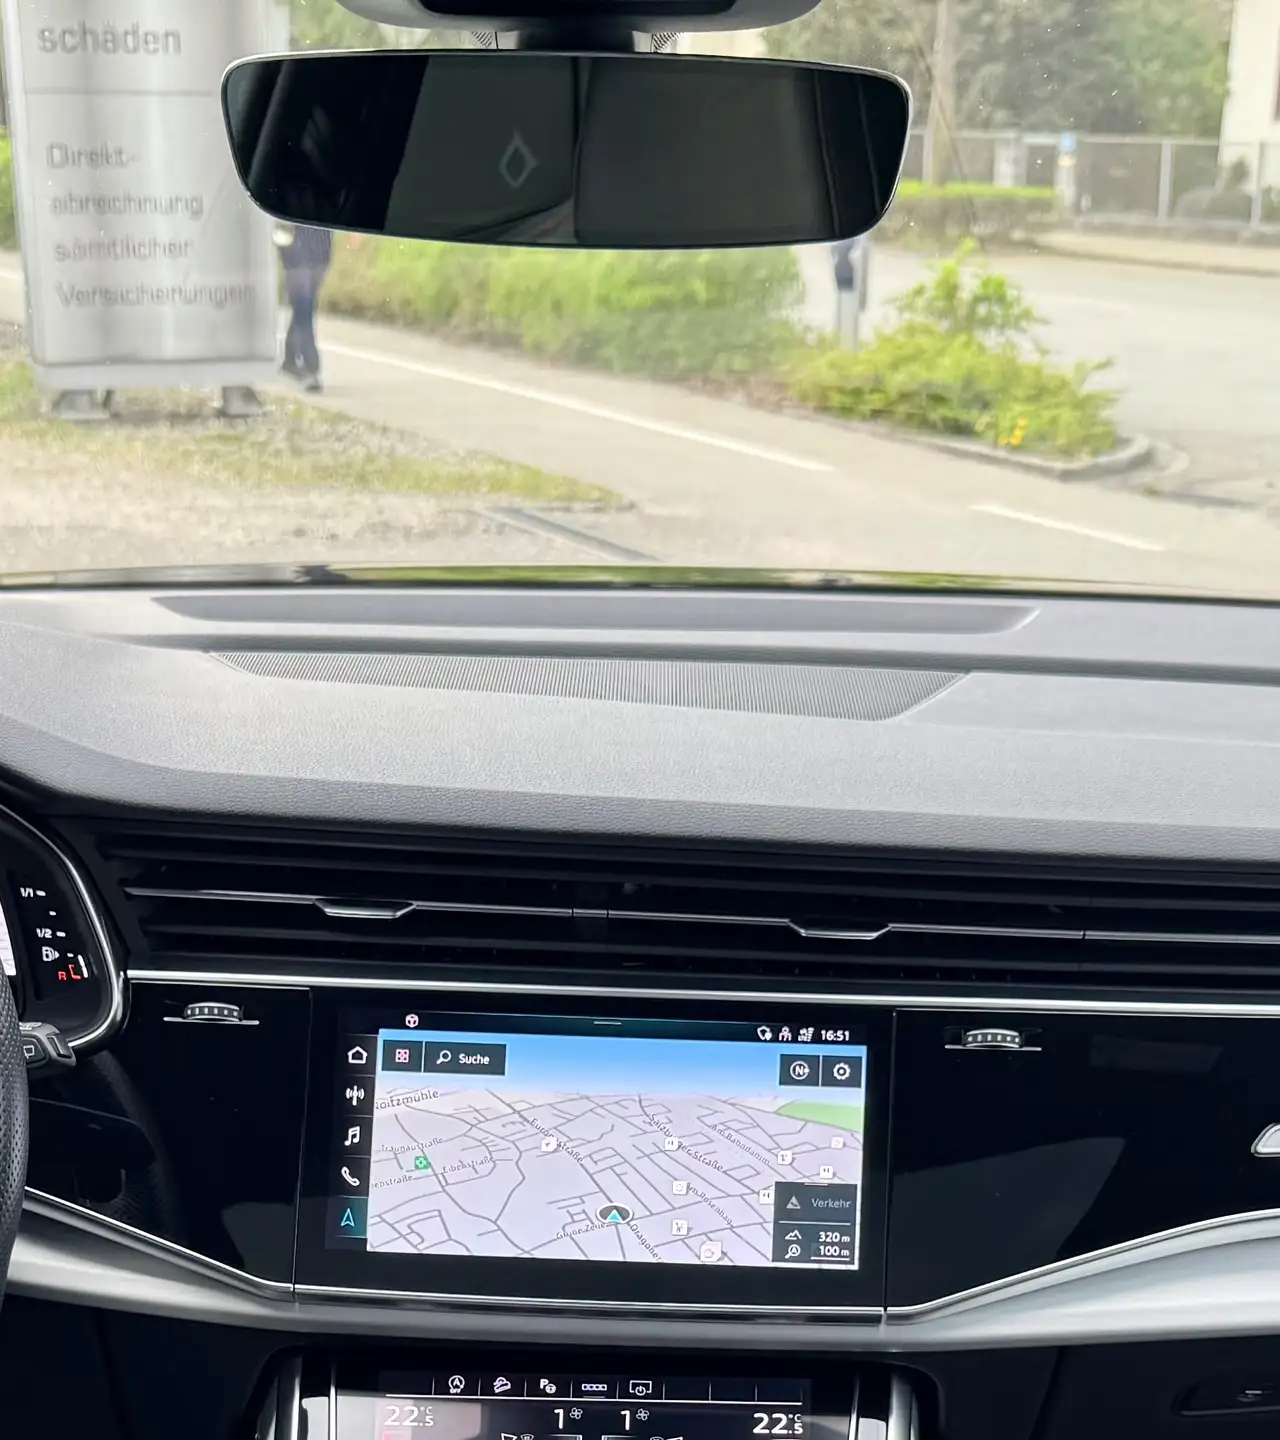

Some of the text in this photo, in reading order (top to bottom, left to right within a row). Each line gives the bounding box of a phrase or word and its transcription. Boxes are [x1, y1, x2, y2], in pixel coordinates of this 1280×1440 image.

[820, 1029, 850, 1041] 16:51
[458, 1053, 490, 1065] Suche
[811, 1198, 852, 1209] Verkehr
[818, 1231, 851, 1243] 320 m
[819, 1245, 840, 1256] 100
